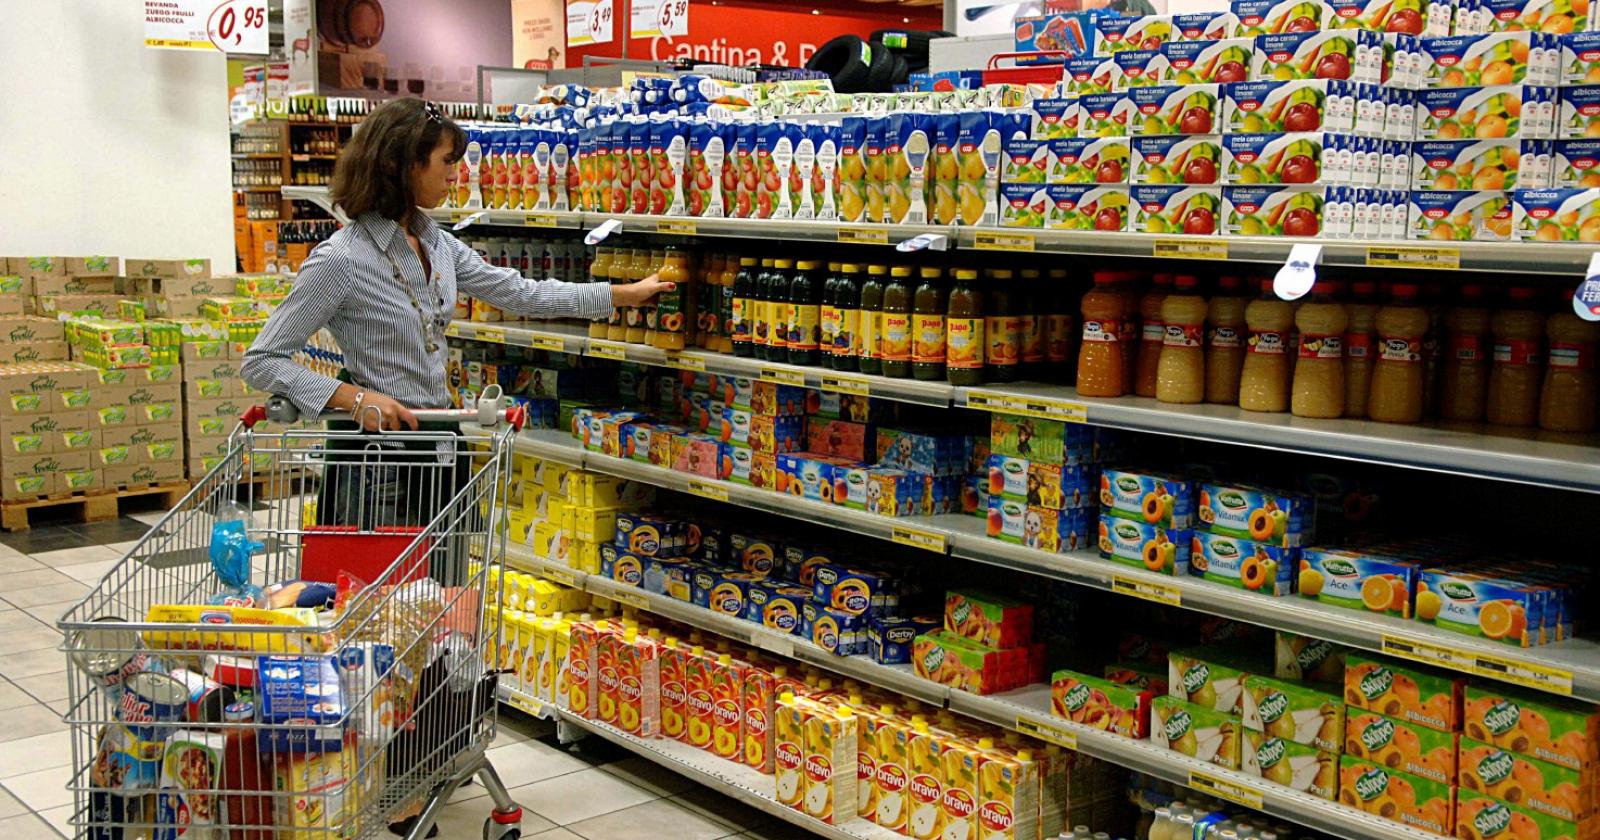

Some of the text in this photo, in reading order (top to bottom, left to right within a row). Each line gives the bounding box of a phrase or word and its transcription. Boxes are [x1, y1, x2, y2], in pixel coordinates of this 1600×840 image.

[592, 7, 612, 34] 3,49
[662, 2, 687, 28] 5,59
[218, 6, 265, 46] 0,95
[651, 36, 789, 67] Cantina &
[1218, 511, 1245, 522] Vitamix
[1211, 559, 1236, 570] Vitamix
[1325, 561, 1354, 573] Valfrutta
[820, 571, 835, 580] Derby
[1330, 579, 1348, 590] Ace
[1443, 583, 1472, 597] Valfrutta
[1448, 603, 1465, 614] Ace
[890, 630, 914, 639] Derby
[1184, 667, 1208, 691] Skipper
[1360, 670, 1394, 698] Skipper
[620, 683, 640, 697] bravo
[1064, 686, 1090, 710] Skipper
[688, 695, 712, 711] bravo
[714, 706, 738, 720] bravo
[1259, 694, 1287, 721] Skipper
[746, 716, 764, 730] bravo
[1164, 713, 1190, 739] Skipper
[1405, 710, 1446, 730] Albicocca
[1484, 702, 1520, 734] Skipper
[1362, 720, 1394, 749] Skipper
[776, 749, 800, 766] bravo
[1257, 740, 1285, 766] Skipper
[1536, 746, 1581, 768] Albicocca
[806, 760, 830, 778] bravo
[1406, 762, 1447, 782] Albicocca
[1477, 754, 1513, 784] Skipper
[876, 772, 905, 789] bravo
[912, 780, 940, 800] bravo
[1356, 770, 1388, 799] Skipper
[944, 794, 972, 814] bravo
[1528, 798, 1572, 818] Albicocca
[981, 808, 1011, 828] bravo
[1401, 812, 1442, 832] Albicocca
[1474, 805, 1511, 836] Skipper
